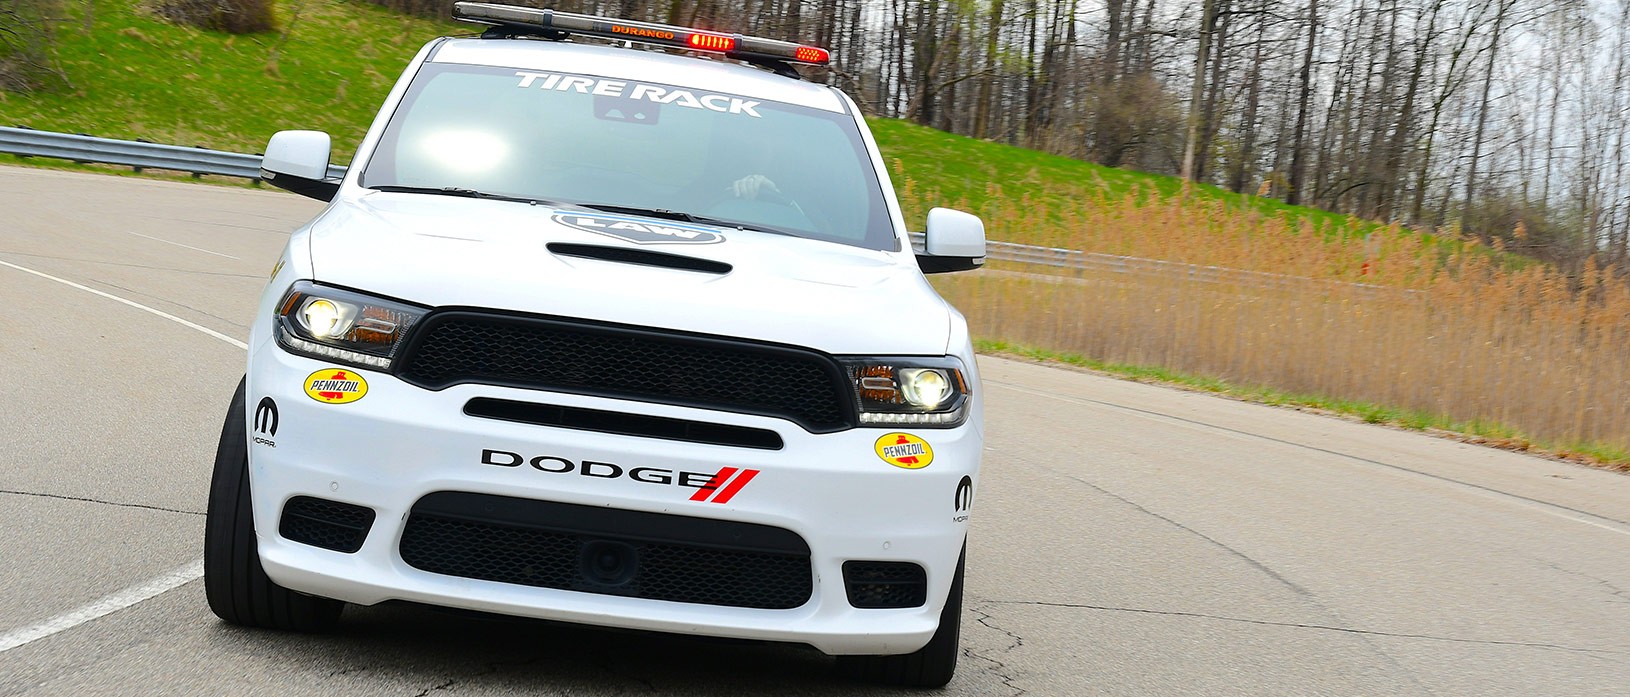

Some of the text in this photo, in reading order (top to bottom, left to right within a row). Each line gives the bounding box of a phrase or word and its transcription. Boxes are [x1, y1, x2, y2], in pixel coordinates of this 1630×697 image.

[611, 25, 675, 40] DURANGO
[515, 71, 763, 119] TIRE RACK
[576, 217, 701, 239] LAW
[309, 379, 359, 392] PENNZOIL
[252, 436, 276, 448] MOPAR
[883, 443, 926, 458] PENNZOIL
[481, 449, 718, 491] DODGE
